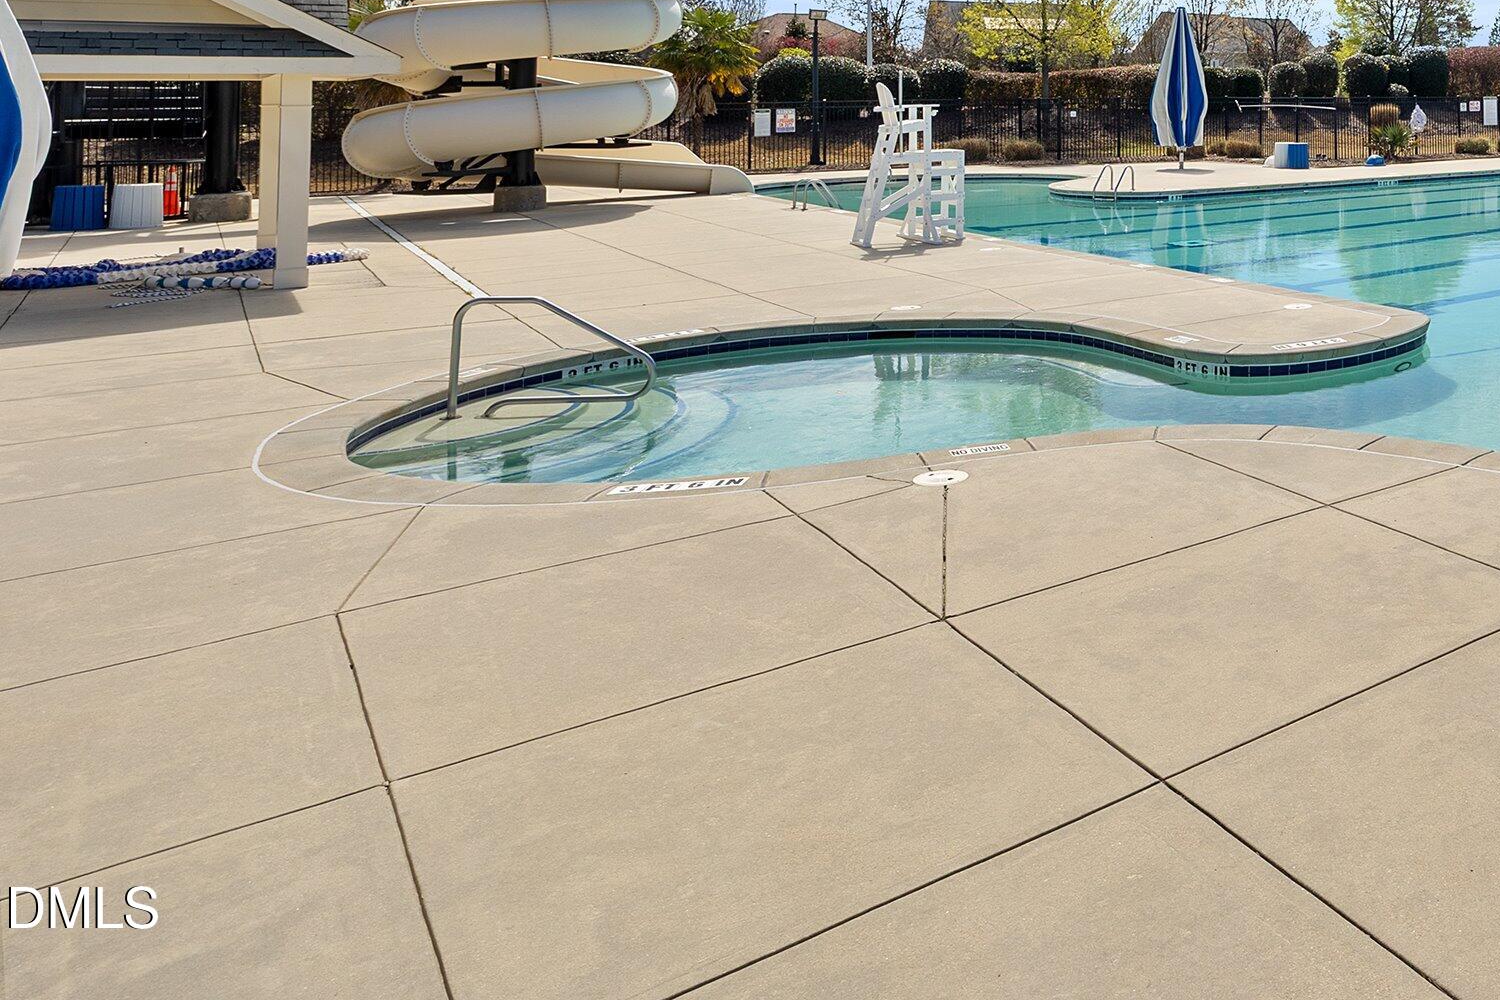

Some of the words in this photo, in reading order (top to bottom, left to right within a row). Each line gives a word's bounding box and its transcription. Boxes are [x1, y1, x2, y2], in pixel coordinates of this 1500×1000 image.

[1185, 362, 1197, 373] FT
[1214, 365, 1228, 376] IN
[970, 444, 1009, 454] DIVING
[645, 483, 677, 491] FT
[715, 478, 744, 486] IN
